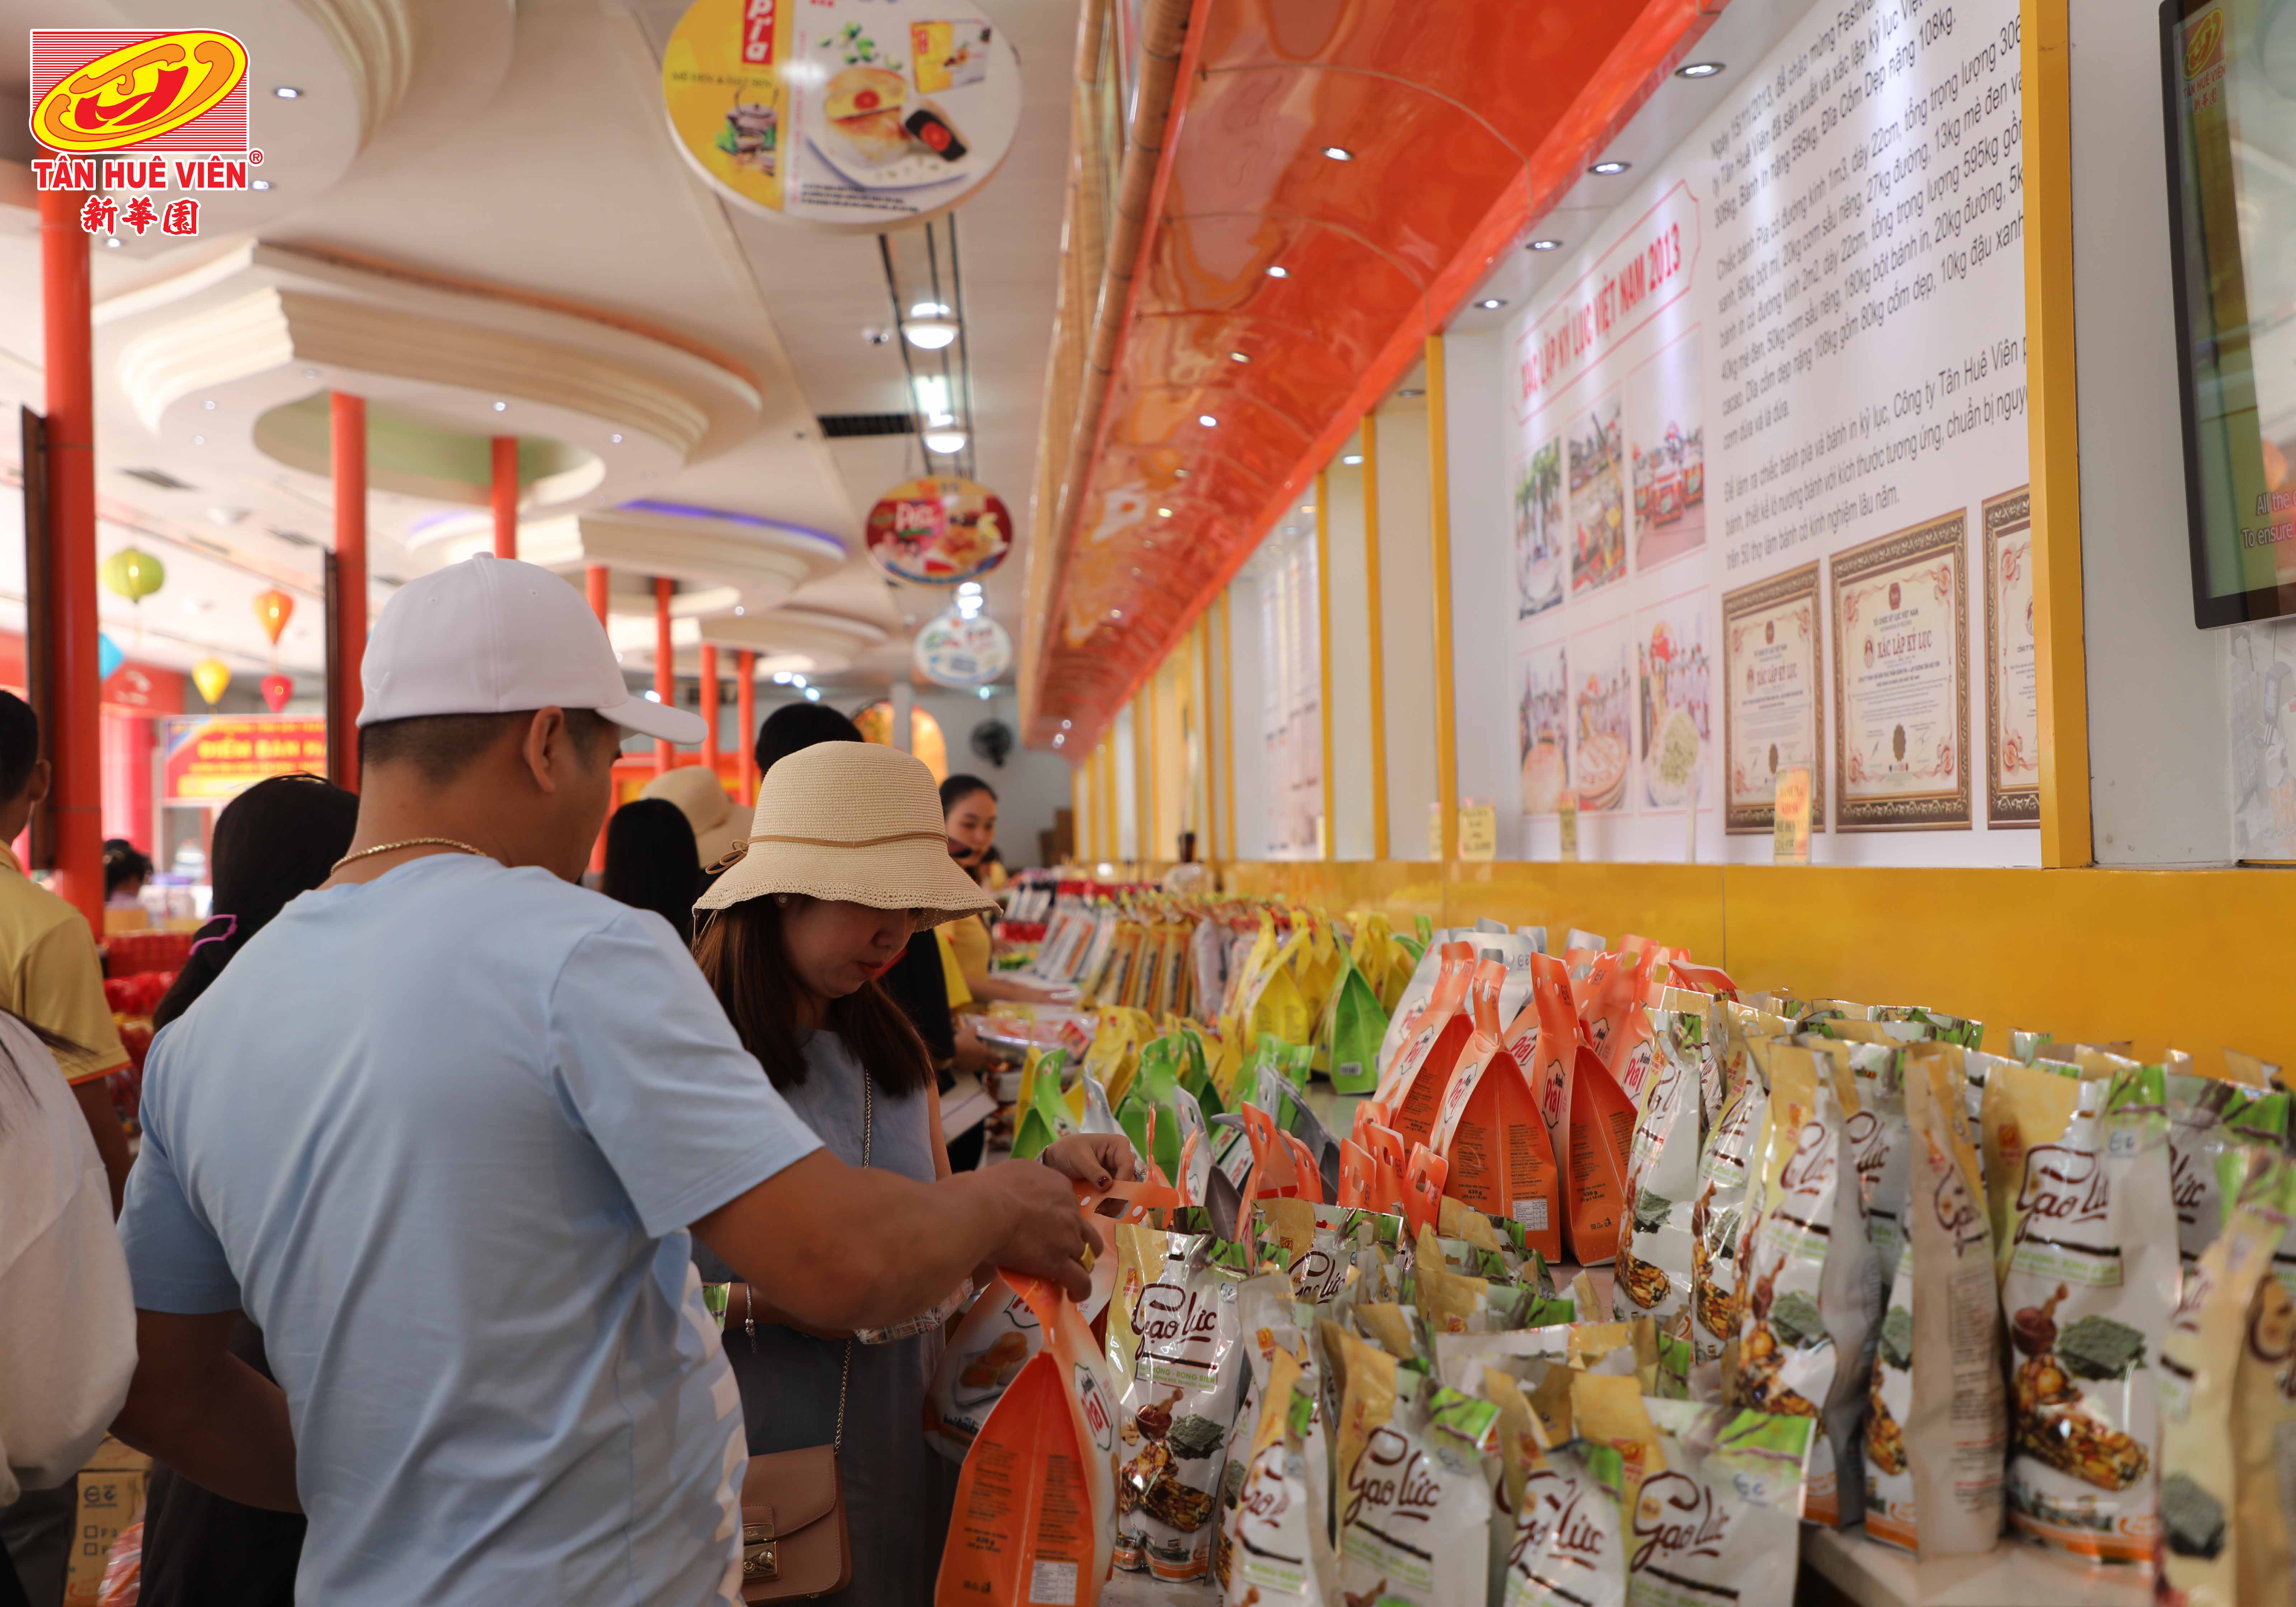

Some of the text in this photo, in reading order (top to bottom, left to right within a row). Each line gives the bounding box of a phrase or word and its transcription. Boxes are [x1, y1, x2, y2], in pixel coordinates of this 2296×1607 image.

[1919, 7, 1955, 49] 108kg.
[1905, 97, 1927, 131] tổng
[1930, 74, 1958, 111] trọng
[1961, 42, 1996, 86] lượng
[1935, 118, 1960, 151] 13kg
[1964, 96, 1981, 131] mè
[1986, 82, 2007, 115] đen
[1927, 165, 1959, 203] lượng
[1964, 137, 1998, 178] 595kg
[1919, 228, 1932, 253] in,
[1935, 209, 1961, 243] 20kg
[1964, 182, 2005, 223] đường,
[1619, 253, 1645, 316] NAM
[1647, 222, 1681, 292] 2013
[1913, 272, 1936, 300] dẹp,
[1941, 251, 1967, 282] 10kg
[1970, 234, 1991, 266] đậu
[1925, 381, 1935, 410] ty
[1938, 368, 1960, 396] Tân
[1964, 350, 1987, 385] Huê
[1991, 338, 2018, 371] Viên
[1947, 397, 1981, 438] chuẩn
[1983, 393, 1994, 425] bị
[2242, 523, 2293, 547] To ensure
[2257, 491, 2290, 515] All the
[1877, 637, 1890, 659] XÁC
[1893, 633, 1906, 655] LẬP
[1131, 1283, 1186, 1361] Gạo
[1176, 1371, 1198, 1381] RONG
[1398, 1450, 1441, 1506] lức
[1630, 1470, 1700, 1573] Gạo
